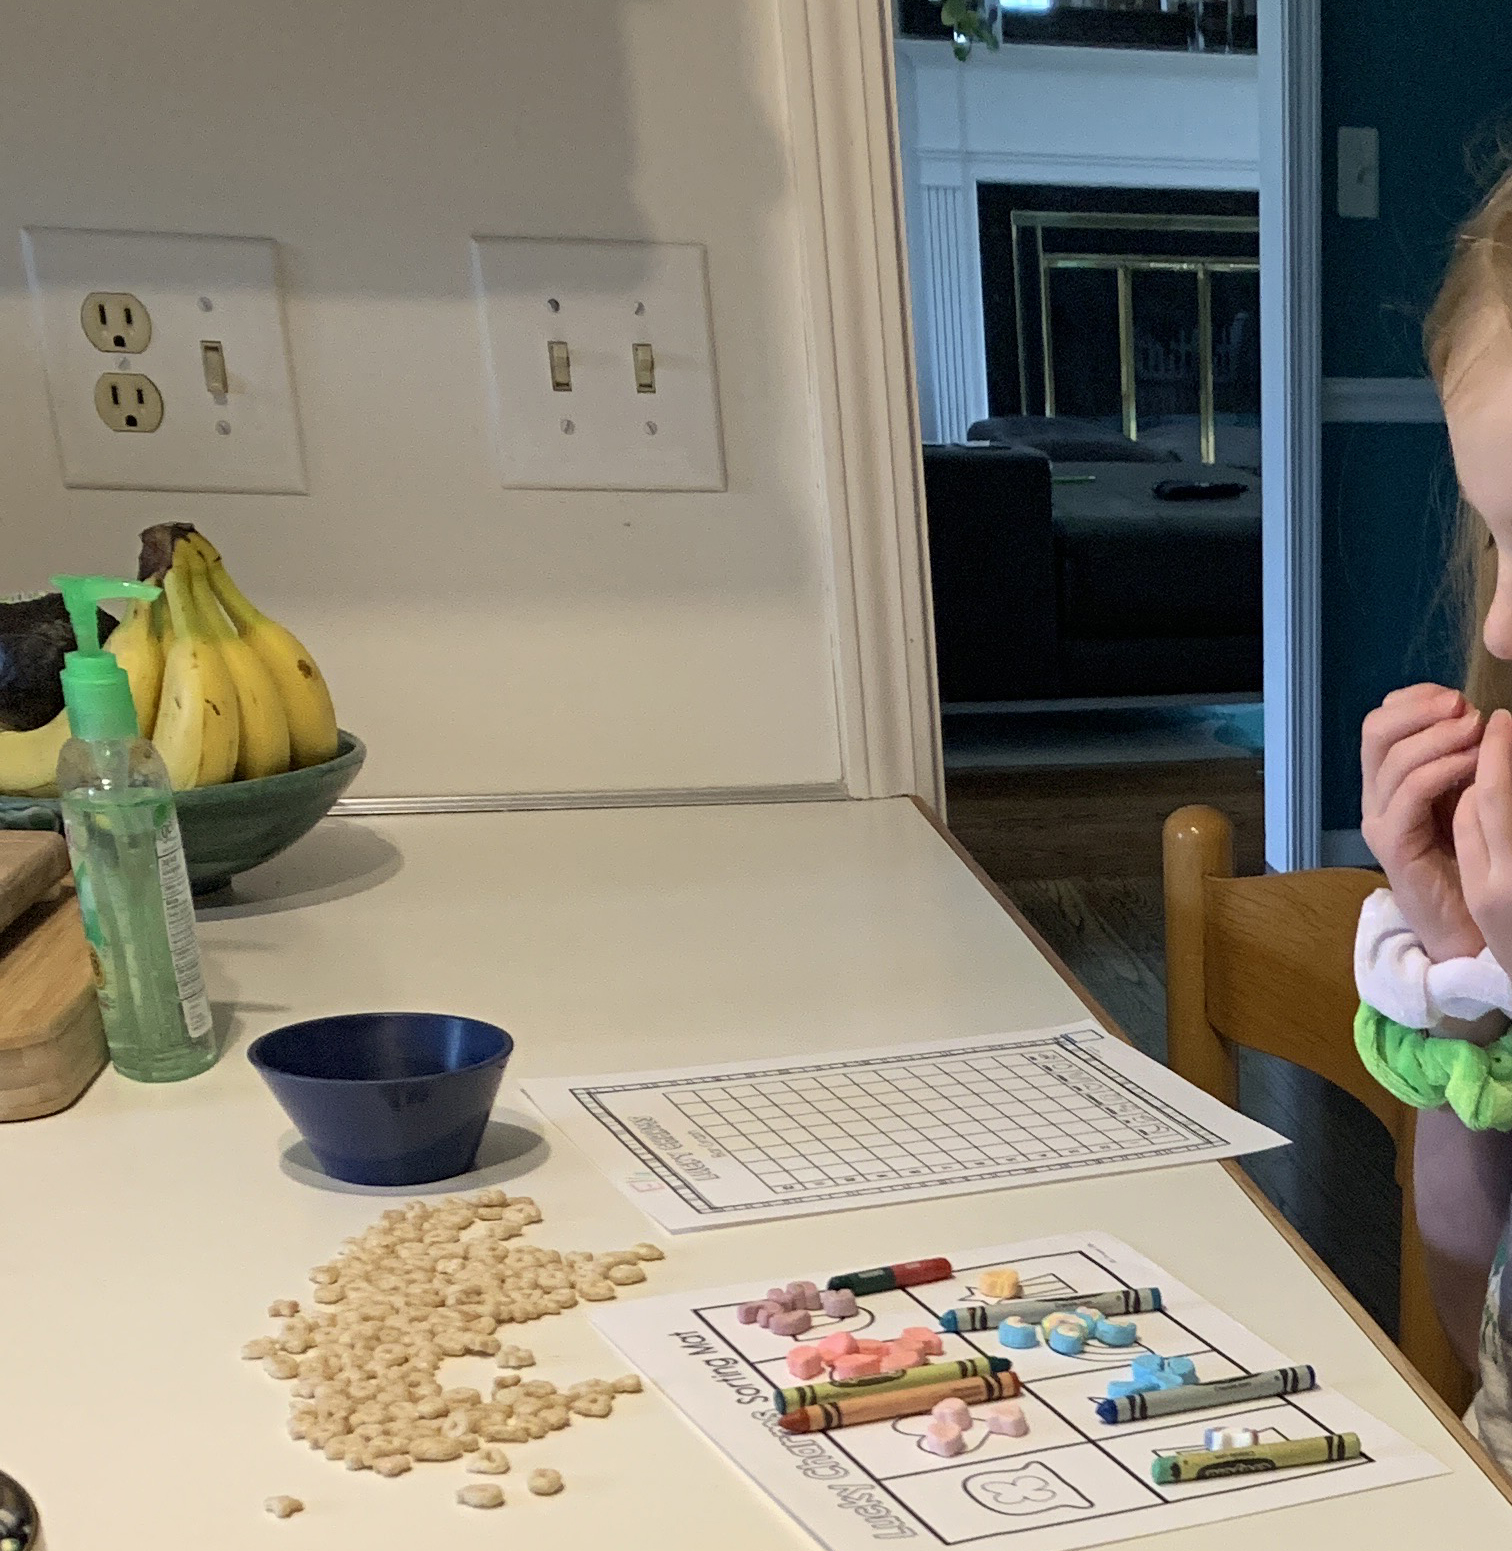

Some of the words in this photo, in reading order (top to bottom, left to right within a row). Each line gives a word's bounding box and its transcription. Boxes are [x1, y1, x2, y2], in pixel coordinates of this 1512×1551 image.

[668, 1331, 718, 1356] Mat
[703, 1357, 768, 1405] Sorting
[827, 1483, 918, 1540] Lucky
